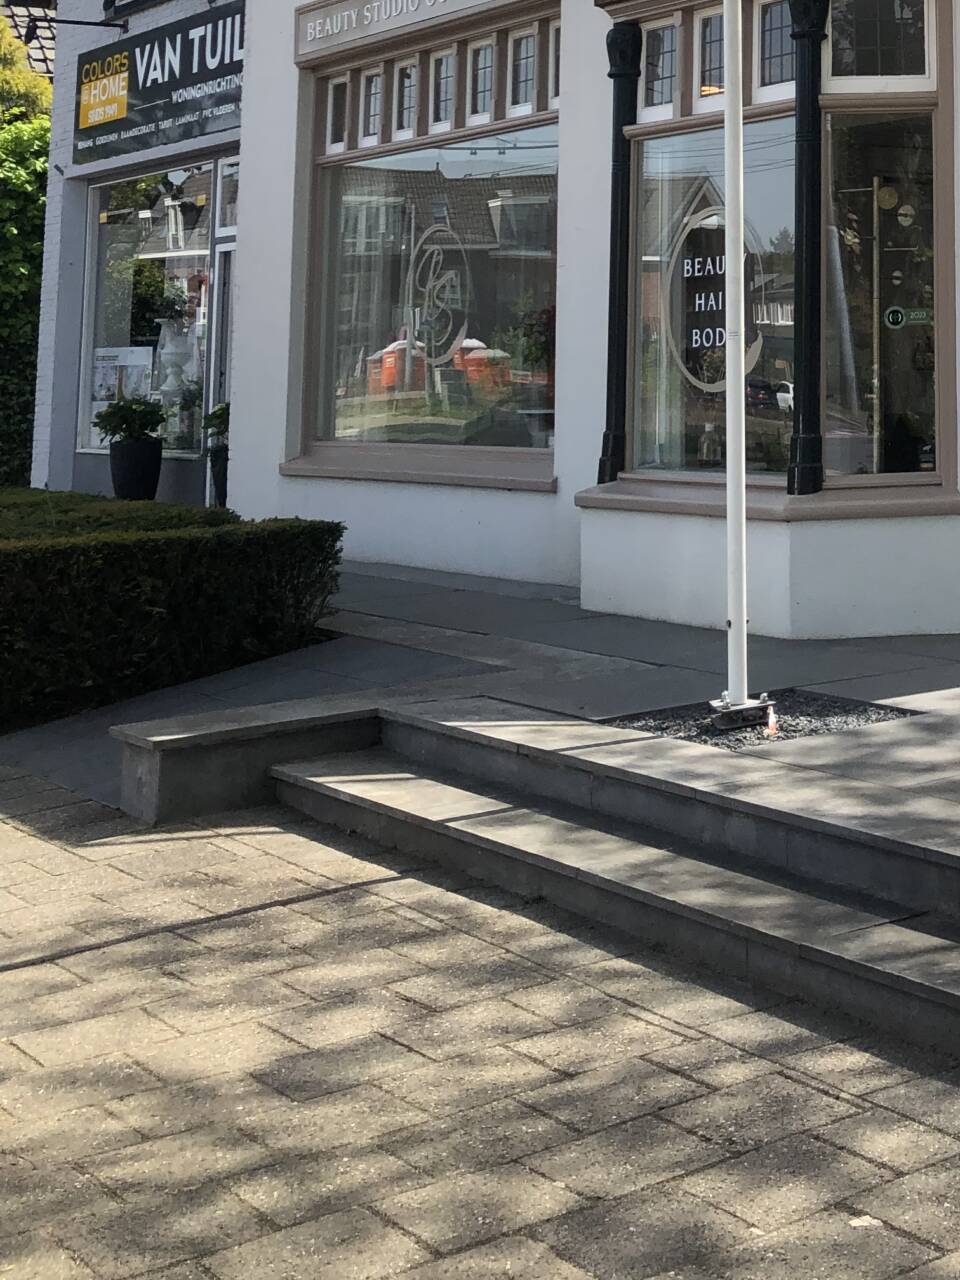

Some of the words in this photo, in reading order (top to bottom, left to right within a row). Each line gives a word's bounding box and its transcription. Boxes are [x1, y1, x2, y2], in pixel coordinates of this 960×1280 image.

[307, 10, 359, 41] BEAUTY
[135, 33, 182, 90] VAN
[189, 14, 244, 73] TUIL
[82, 51, 129, 83] COLORS
[683, 253, 747, 278] BEAU
[695, 291, 723, 312] HAI
[692, 327, 726, 348] BOD
